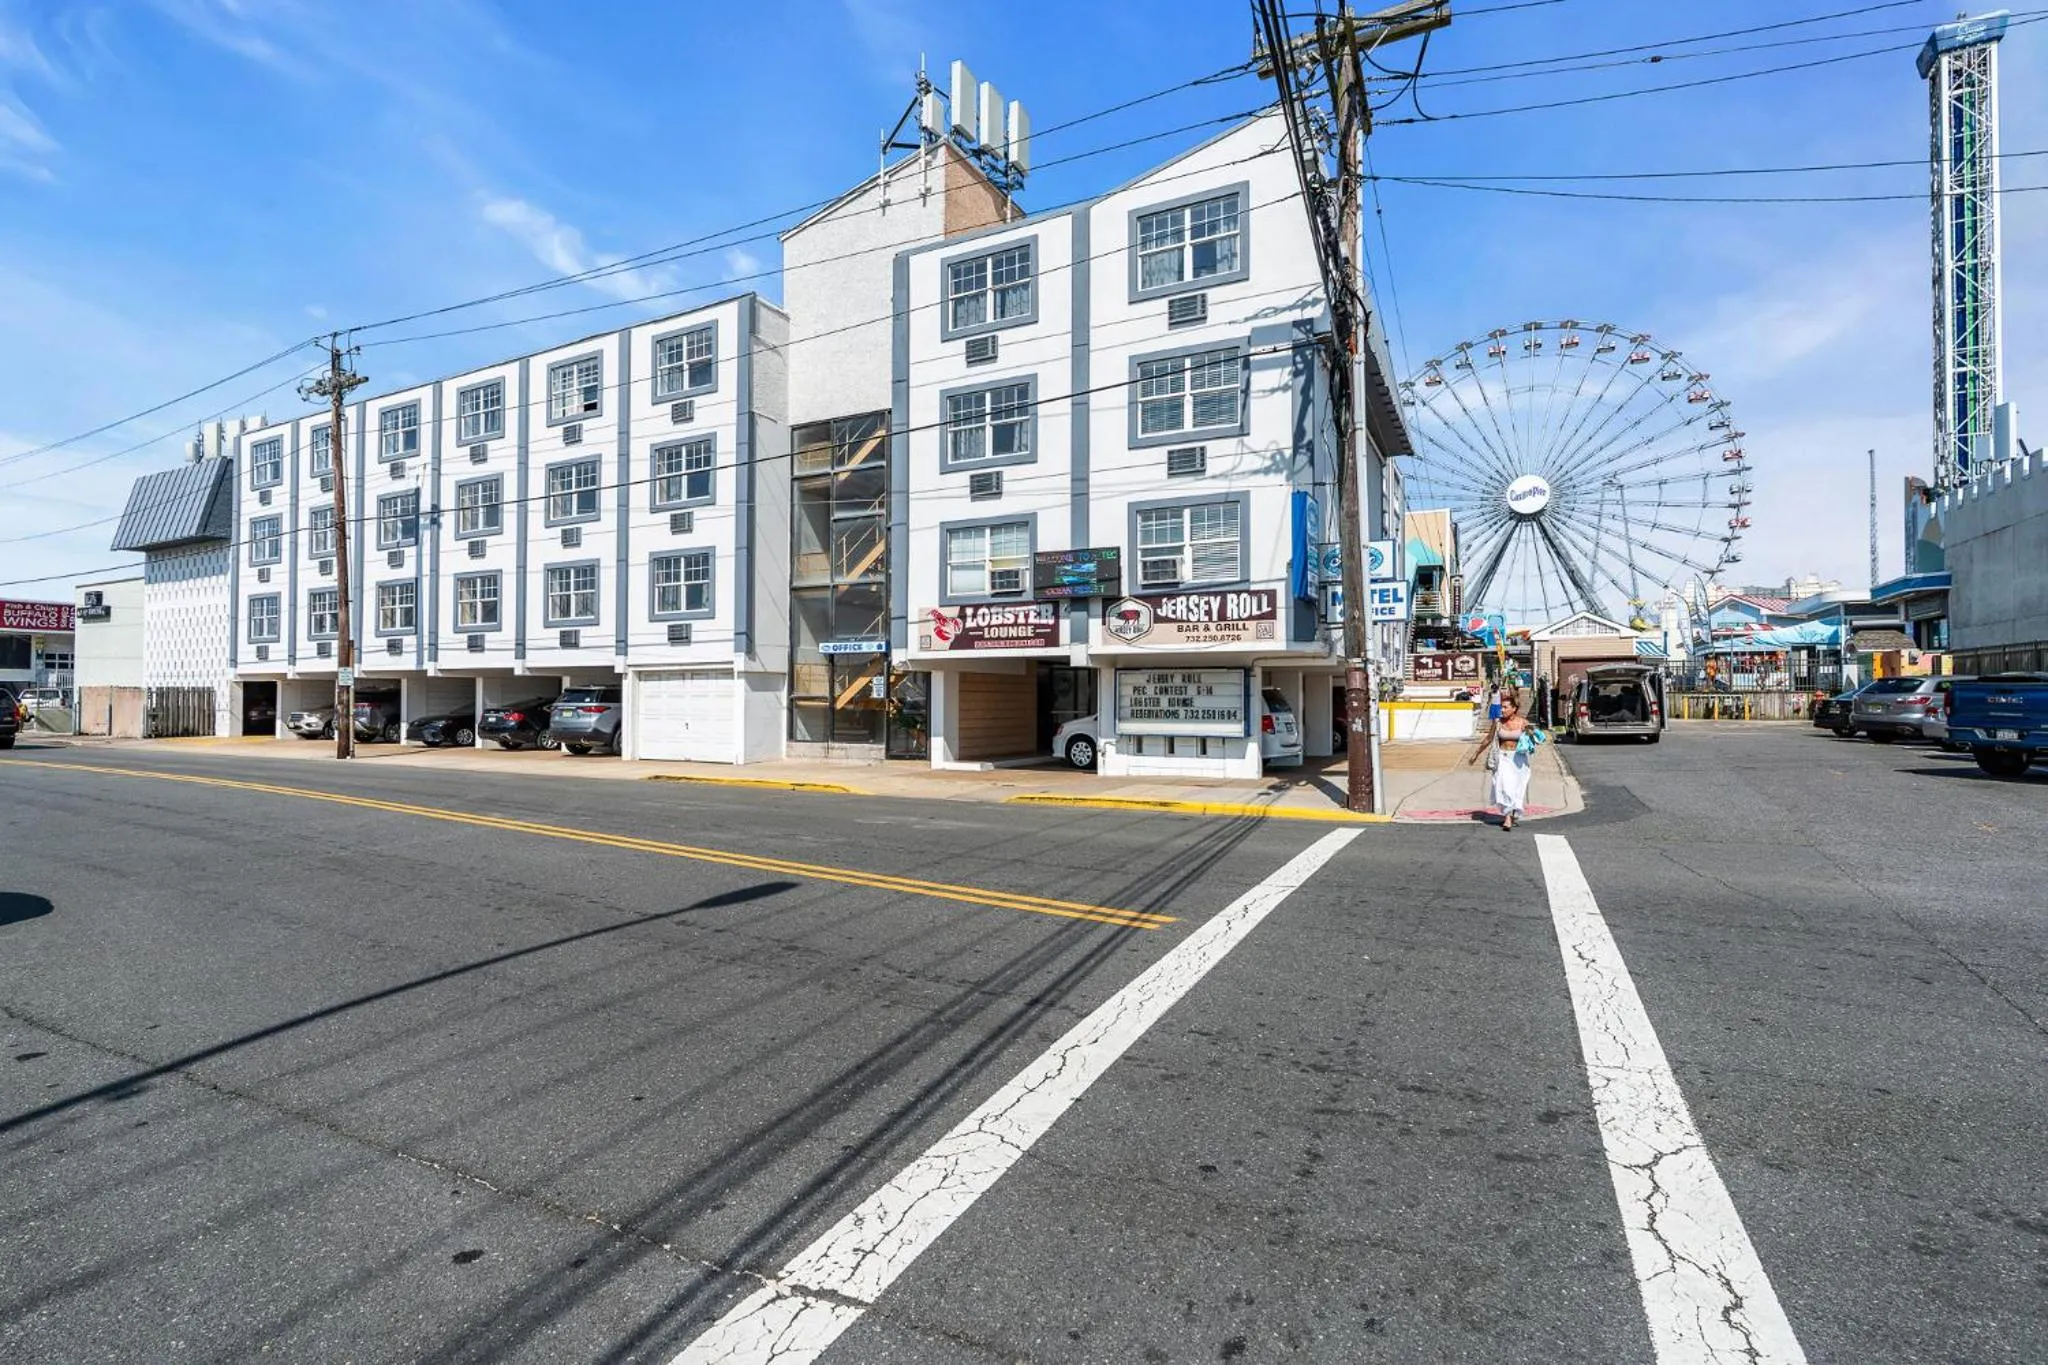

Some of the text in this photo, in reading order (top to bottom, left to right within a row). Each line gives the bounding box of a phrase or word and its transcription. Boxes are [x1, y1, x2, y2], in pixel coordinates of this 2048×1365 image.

[1331, 588, 1404, 607] MTEL
[1156, 593, 1272, 622] JERSEY ROLL
[1338, 606, 1396, 618] ICE
[3, 609, 58, 619] BUFFALO
[965, 603, 1055, 629] LOBSTER
[3, 616, 58, 628] WINGS
[1176, 622, 1249, 633] BAR & GRILL
[983, 625, 1035, 638] LOUNGE
[832, 644, 862, 652] OFFICE
[1146, 672, 1175, 684] JERSEY
[1153, 685, 1188, 695] CONTEST
[1129, 697, 1160, 707] LOBSTER
[1130, 709, 1180, 719] RESERVATIONS
